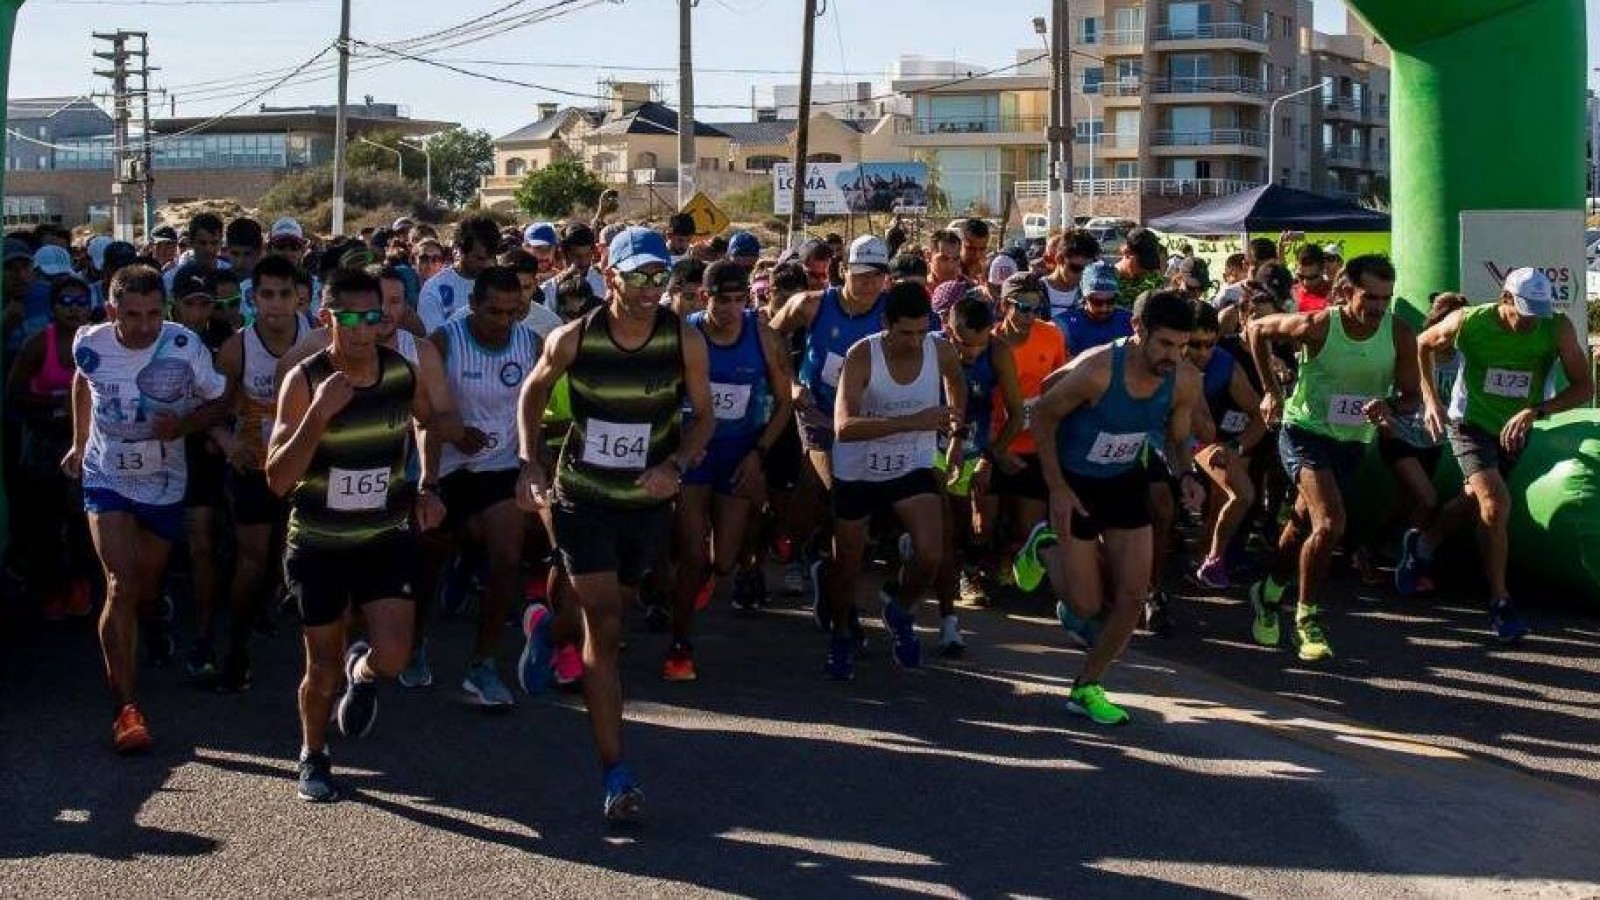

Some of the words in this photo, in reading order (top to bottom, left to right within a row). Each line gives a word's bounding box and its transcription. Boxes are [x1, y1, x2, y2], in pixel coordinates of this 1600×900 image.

[596, 433, 646, 458] 164
[115, 452, 143, 470] 13
[340, 472, 388, 495] 165
